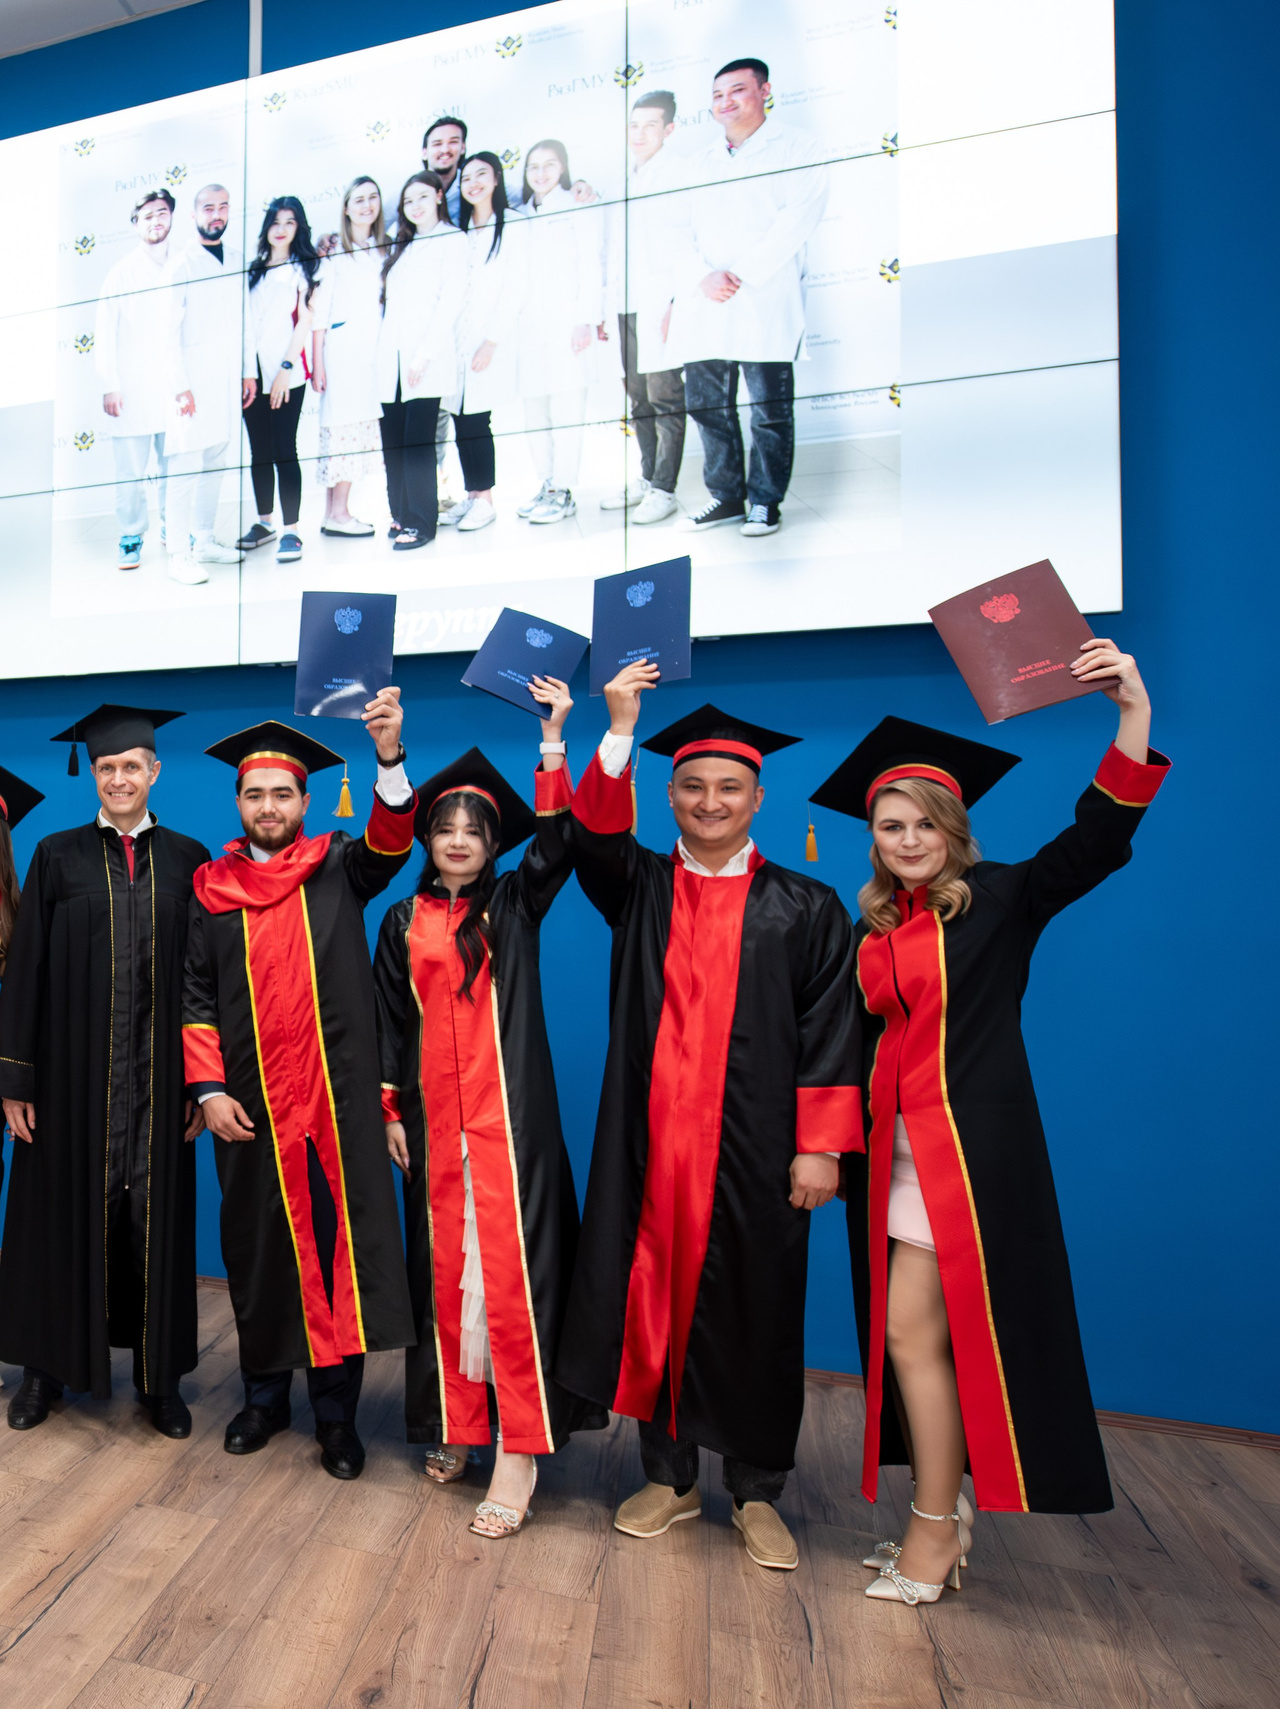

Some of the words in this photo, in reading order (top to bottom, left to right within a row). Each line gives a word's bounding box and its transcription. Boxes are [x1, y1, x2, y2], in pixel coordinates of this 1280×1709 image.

[548, 72, 608, 98] РязГМУ
[115, 170, 161, 192] РязГМУ
[626, 647, 651, 656] ВЫСШЕЕ
[1011, 663, 1066, 683] ОБРАЗОВАНИЕ
[1018, 659, 1051, 673] ВЫСШЕЕ
